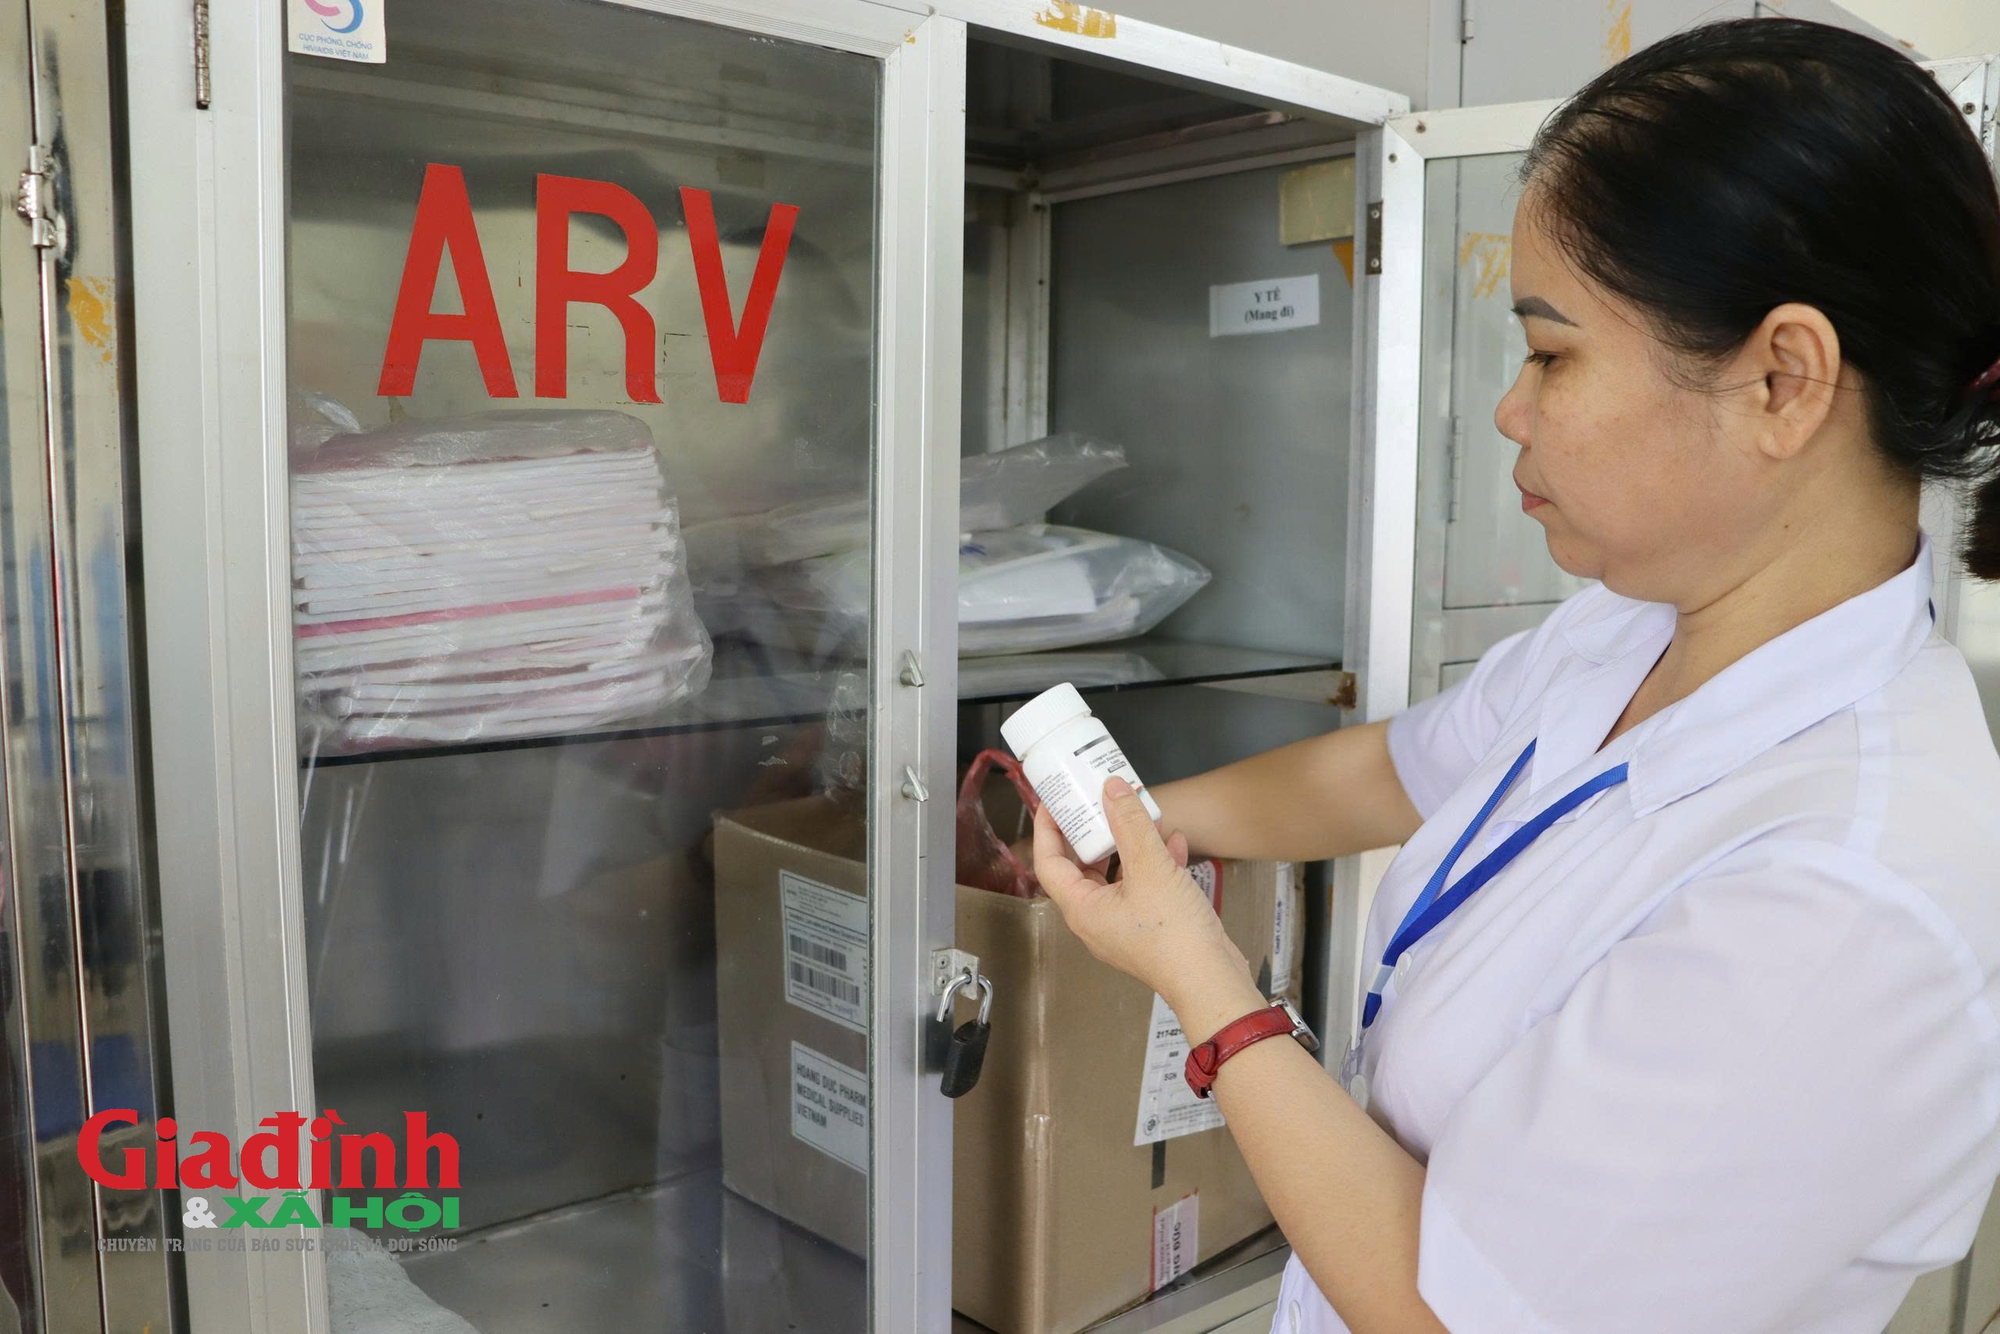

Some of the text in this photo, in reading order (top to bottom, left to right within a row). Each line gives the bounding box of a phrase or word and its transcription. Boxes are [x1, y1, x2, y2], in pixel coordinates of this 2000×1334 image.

[299, 33, 314, 42] CỤC
[335, 47, 351, 58] VIỆT
[353, 51, 368, 60] NAM
[377, 163, 799, 404] ARV
[1254, 291, 1262, 304] Y
[1244, 306, 1294, 323] (Mang đi)
[797, 1063, 821, 1085] HOANG
[797, 1082, 864, 1127] MEDICAL SUPPLIES
[797, 1102, 827, 1128] VIETNAM
